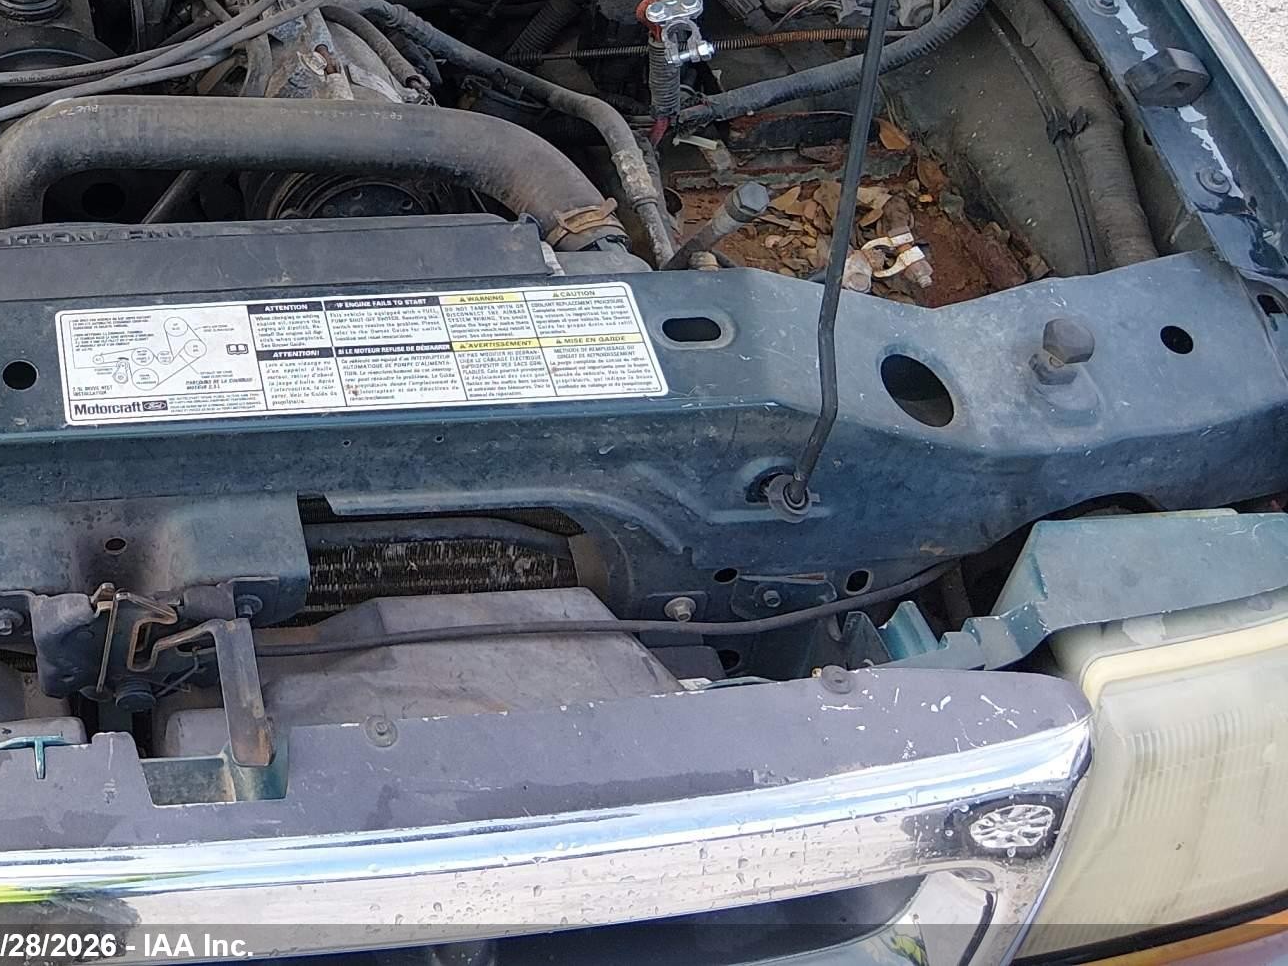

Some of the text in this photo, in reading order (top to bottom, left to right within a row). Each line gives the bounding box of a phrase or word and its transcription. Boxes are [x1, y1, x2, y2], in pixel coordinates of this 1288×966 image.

[467, 340, 532, 348] AVERTISSEMENT
[271, 349, 320, 358] ATTENTION!
[74, 401, 141, 415] Motorcraft
